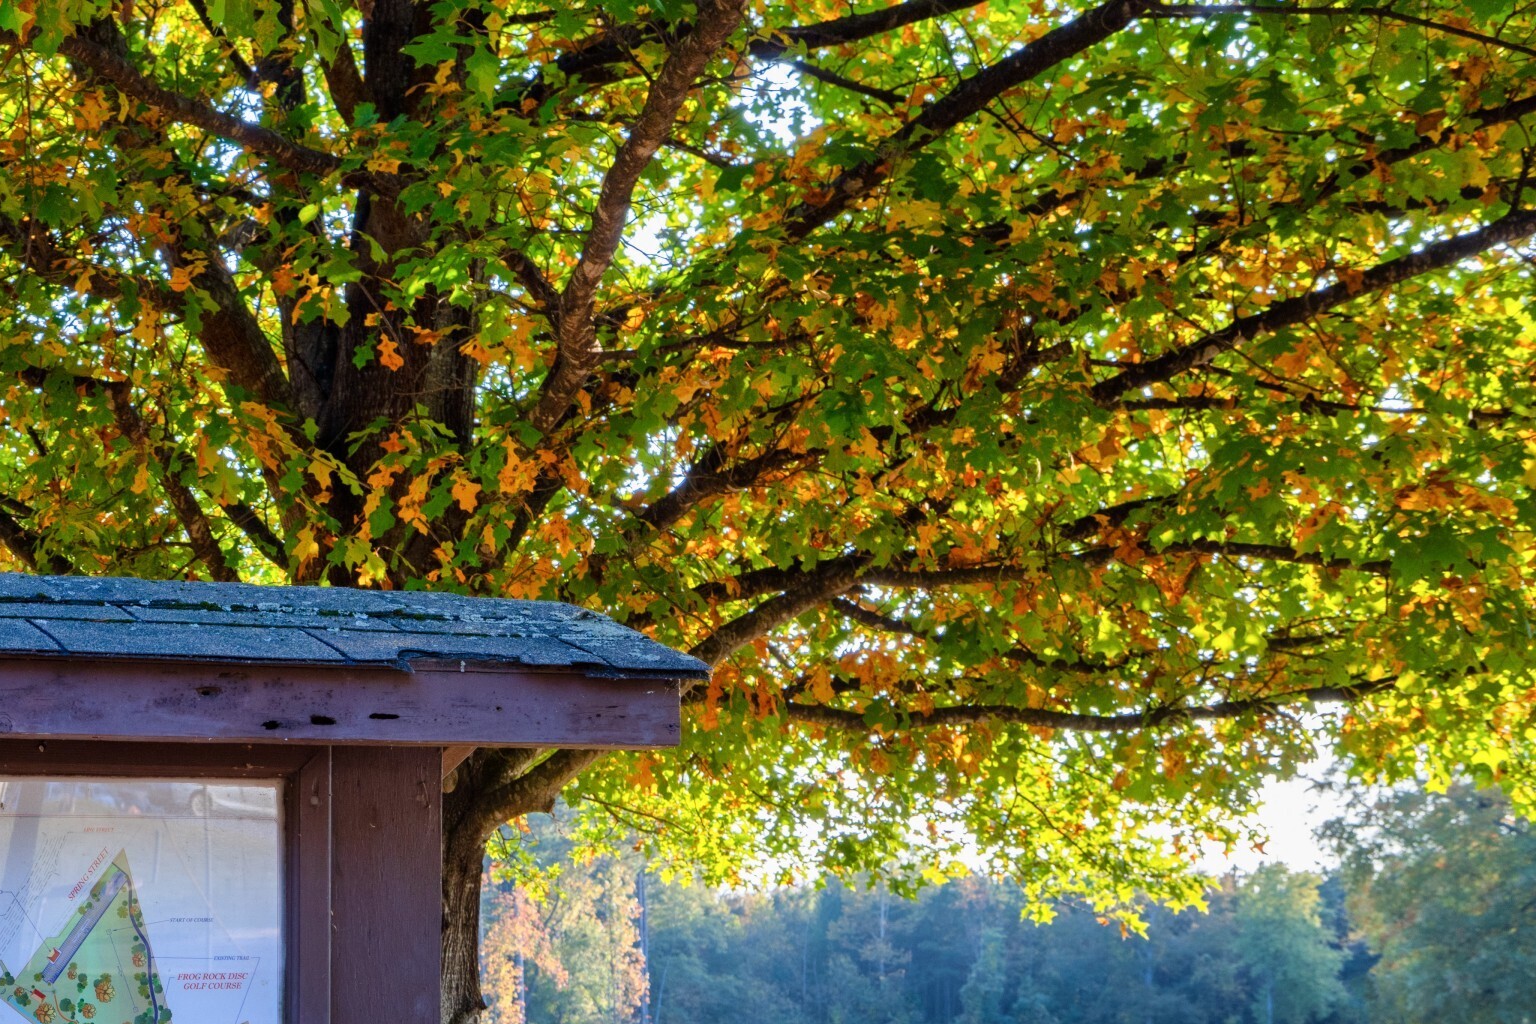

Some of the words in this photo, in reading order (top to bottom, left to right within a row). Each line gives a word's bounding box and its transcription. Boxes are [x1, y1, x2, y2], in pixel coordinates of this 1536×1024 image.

[68, 873, 89, 901] SPRING
[87, 846, 109, 876] STREET
[177, 973, 202, 981] FROG
[202, 972, 226, 980] ROCK
[227, 972, 249, 980] DISC
[208, 982, 242, 990] COURSE
